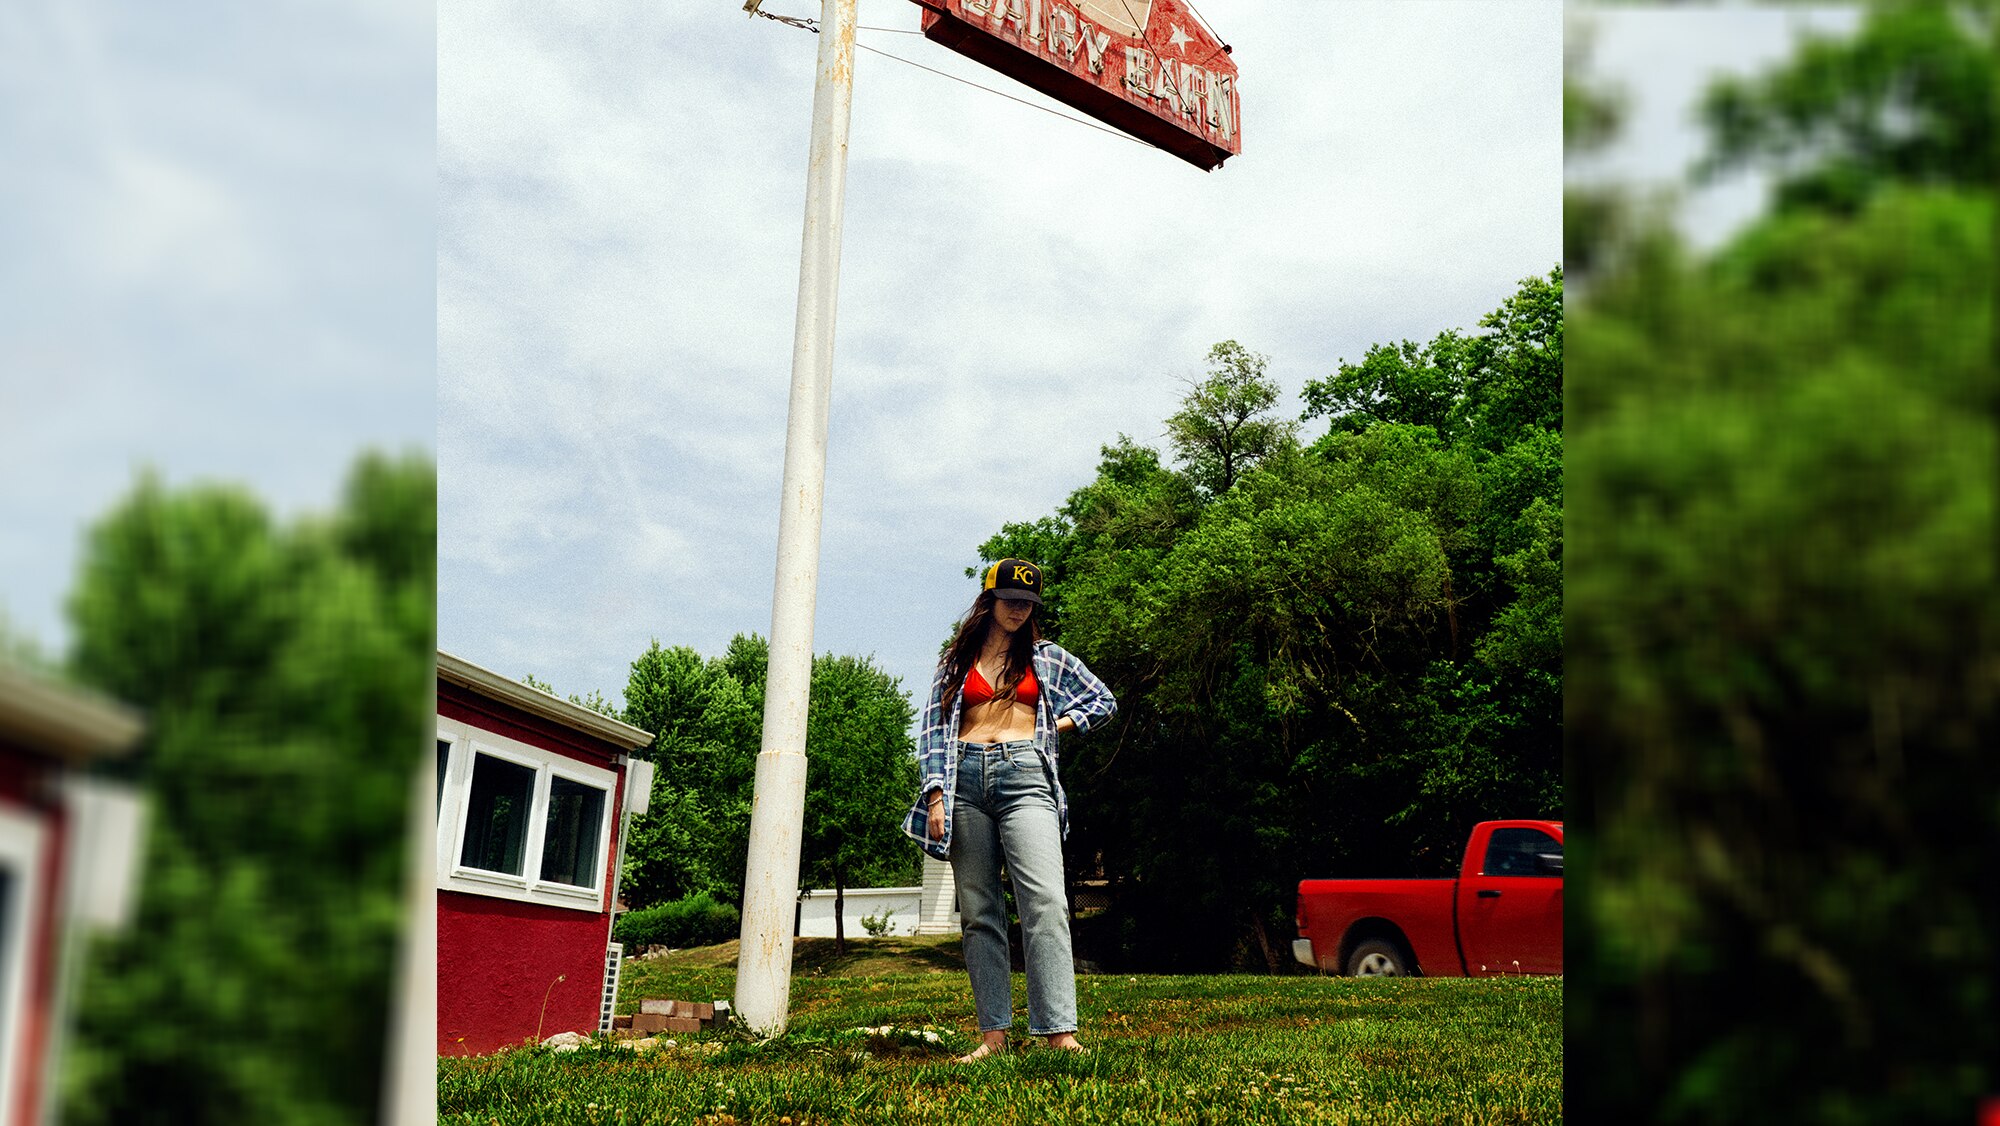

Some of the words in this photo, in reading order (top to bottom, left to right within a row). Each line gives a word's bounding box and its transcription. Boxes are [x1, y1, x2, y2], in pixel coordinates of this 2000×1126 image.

[961, 0, 1111, 75] AIRY
[1123, 46, 1236, 141] BARN
[1012, 565, 1034, 585] KC
